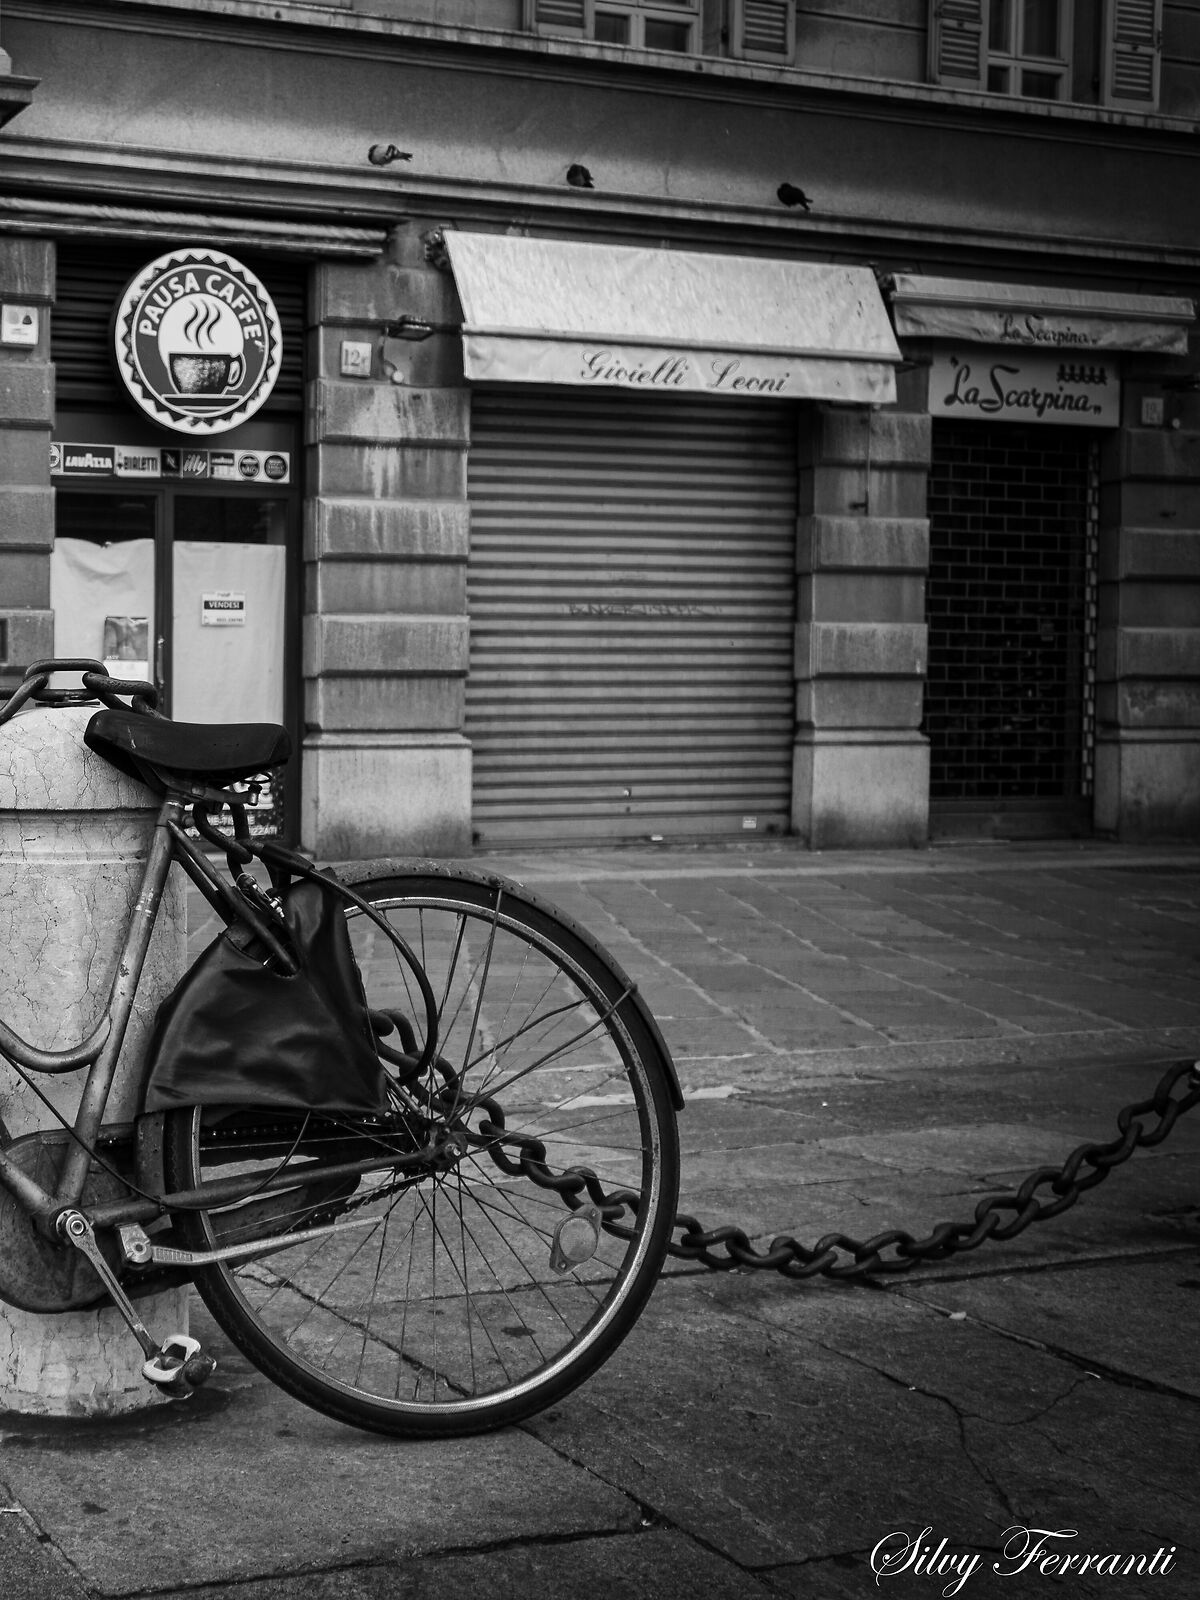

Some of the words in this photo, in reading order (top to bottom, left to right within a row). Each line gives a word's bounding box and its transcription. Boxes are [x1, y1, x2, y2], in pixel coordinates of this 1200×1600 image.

[138, 272, 201, 337] PAUSA
[581, 351, 689, 386] Gioielli
[706, 358, 790, 392] Leoni
[64, 453, 113, 469] LAVAZZA
[183, 454, 207, 476] illy
[208, 601, 240, 609] VENDESI
